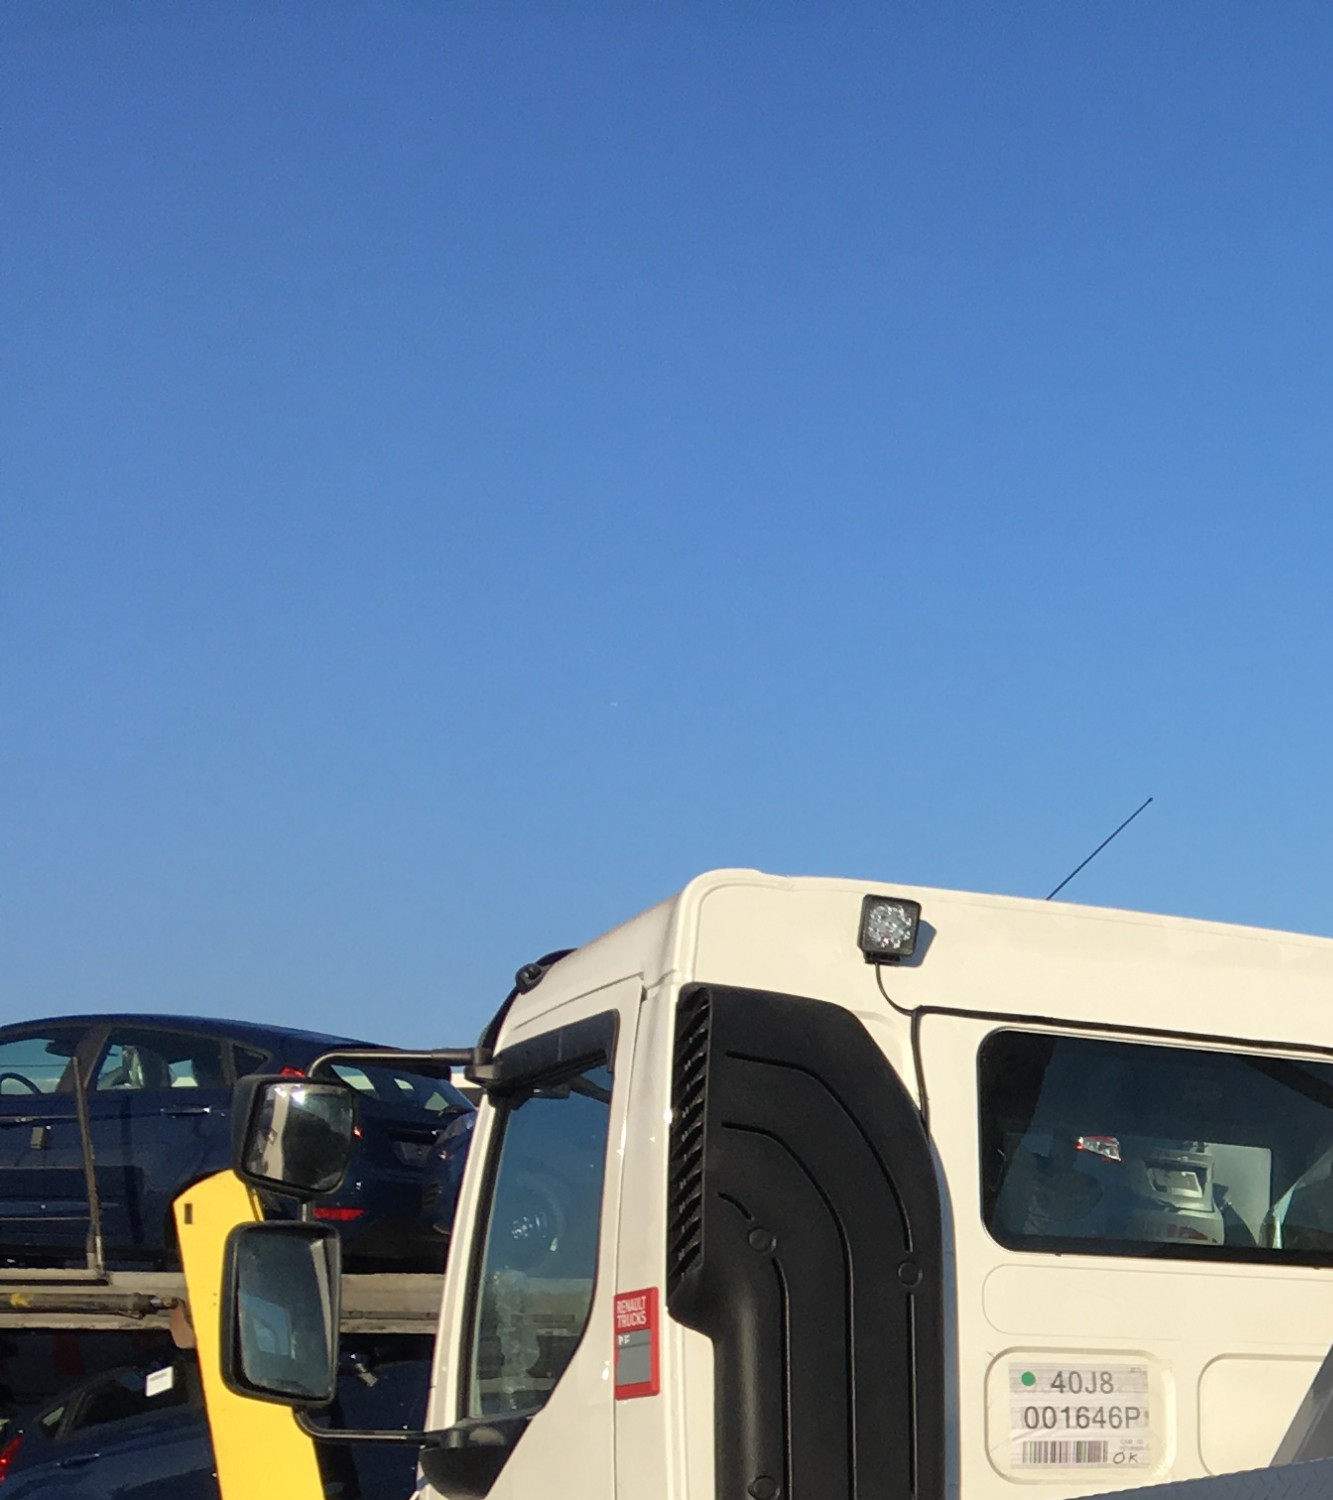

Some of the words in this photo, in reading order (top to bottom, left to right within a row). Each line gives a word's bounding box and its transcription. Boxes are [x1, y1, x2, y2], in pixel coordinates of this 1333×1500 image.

[617, 1296, 646, 1314] RENAULT
[617, 1311, 646, 1328] TRUCKS
[1051, 1371, 1114, 1394] 40J8
[1024, 1406, 1140, 1429] 001646P
